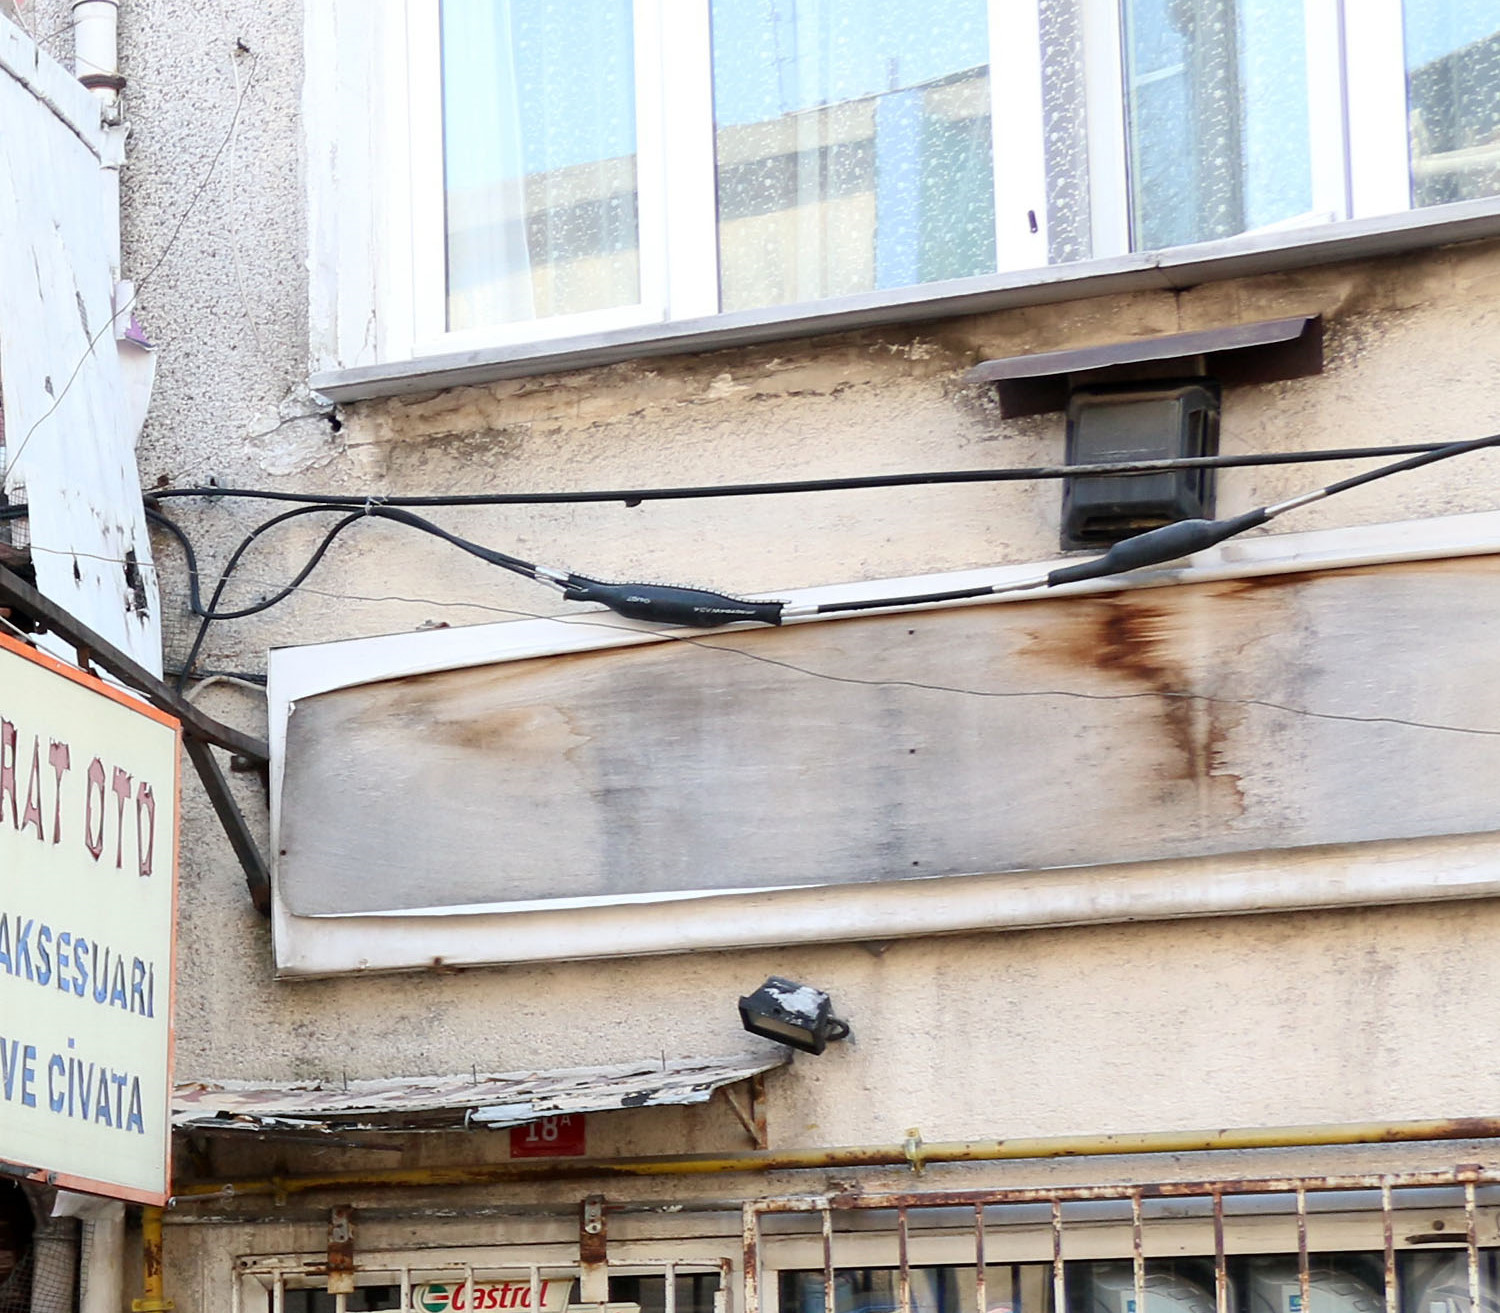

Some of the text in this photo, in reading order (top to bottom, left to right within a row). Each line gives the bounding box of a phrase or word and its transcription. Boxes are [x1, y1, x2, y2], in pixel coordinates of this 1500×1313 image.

[86, 757, 156, 876] OTO
[0, 1037, 37, 1108] VE
[48, 1037, 145, 1134] CİVATA
